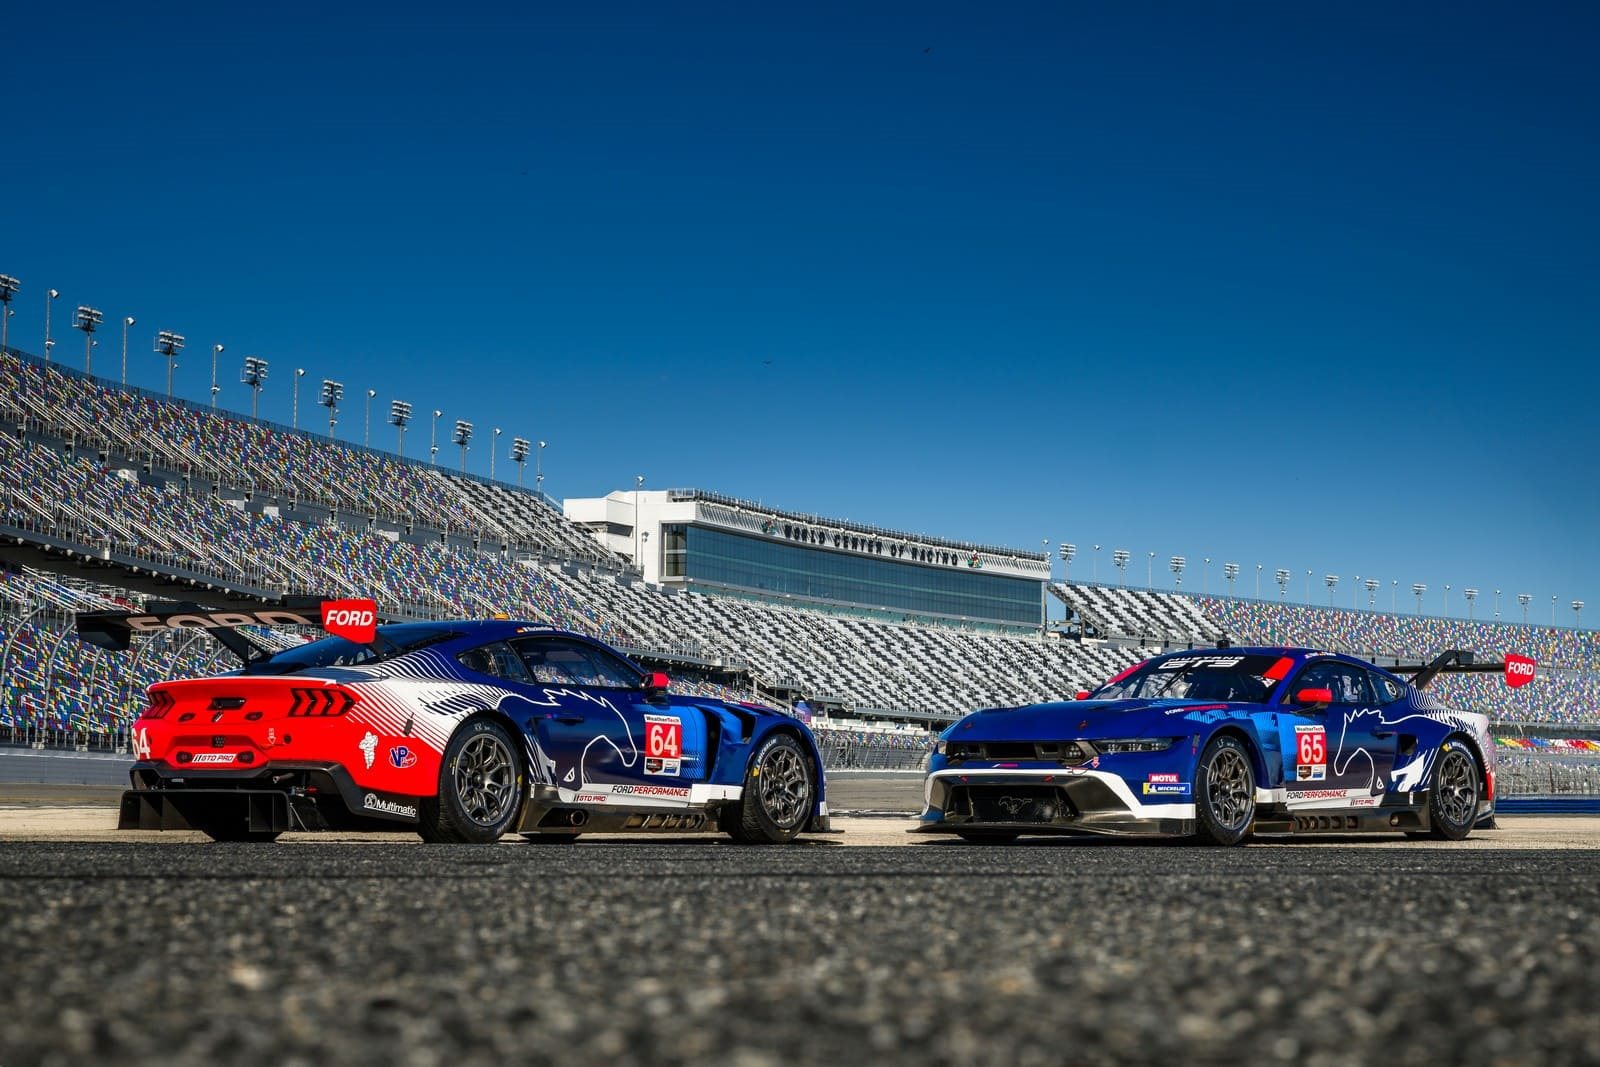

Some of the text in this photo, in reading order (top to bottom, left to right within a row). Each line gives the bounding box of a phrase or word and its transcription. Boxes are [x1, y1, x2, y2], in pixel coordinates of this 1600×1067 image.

[325, 609, 373, 627] FORD
[1507, 661, 1534, 676] FORD
[650, 724, 678, 757] 64
[1300, 734, 1324, 763] 65
[390, 746, 409, 767] VP
[1151, 775, 1177, 783] MOTUL
[377, 799, 417, 816] Multimatic
